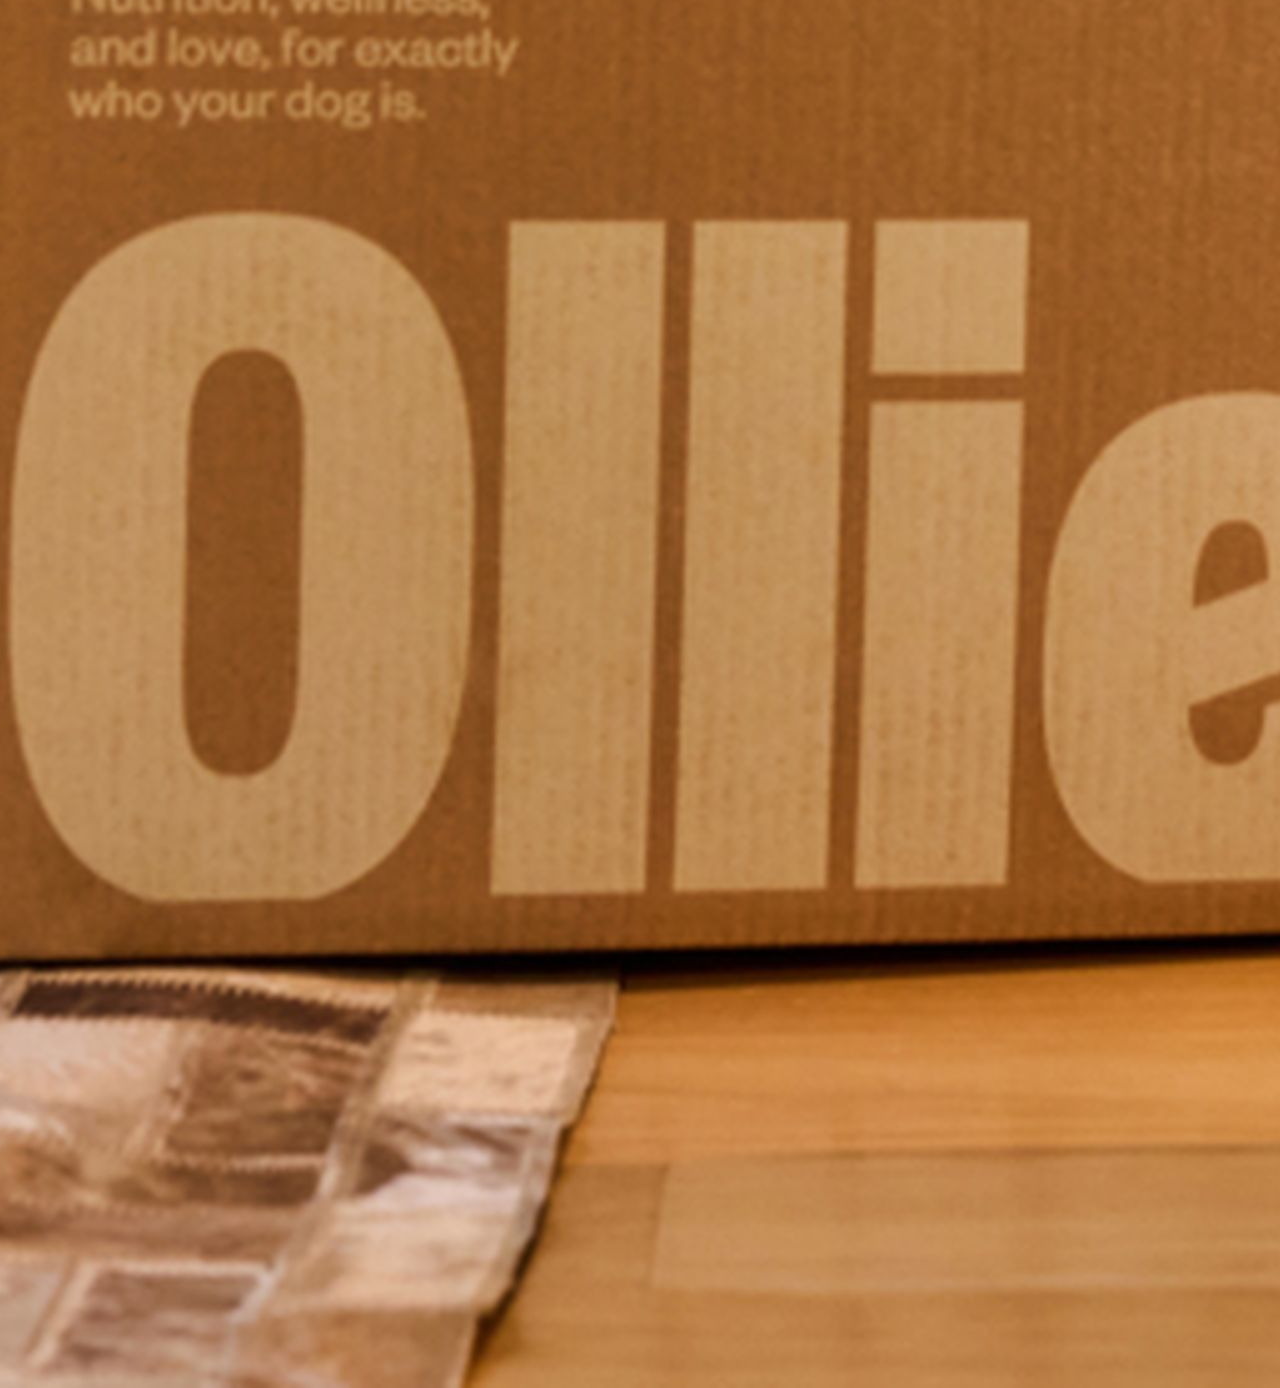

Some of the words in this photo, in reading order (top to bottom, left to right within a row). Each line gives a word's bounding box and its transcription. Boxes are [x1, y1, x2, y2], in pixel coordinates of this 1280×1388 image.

[69, 27, 154, 68] and
[167, 27, 272, 72] love,
[280, 27, 345, 68] for
[353, 28, 518, 76] exactly
[68, 80, 163, 120] who
[173, 88, 276, 127] your
[284, 81, 371, 129] dog
[379, 80, 427, 120] is.
